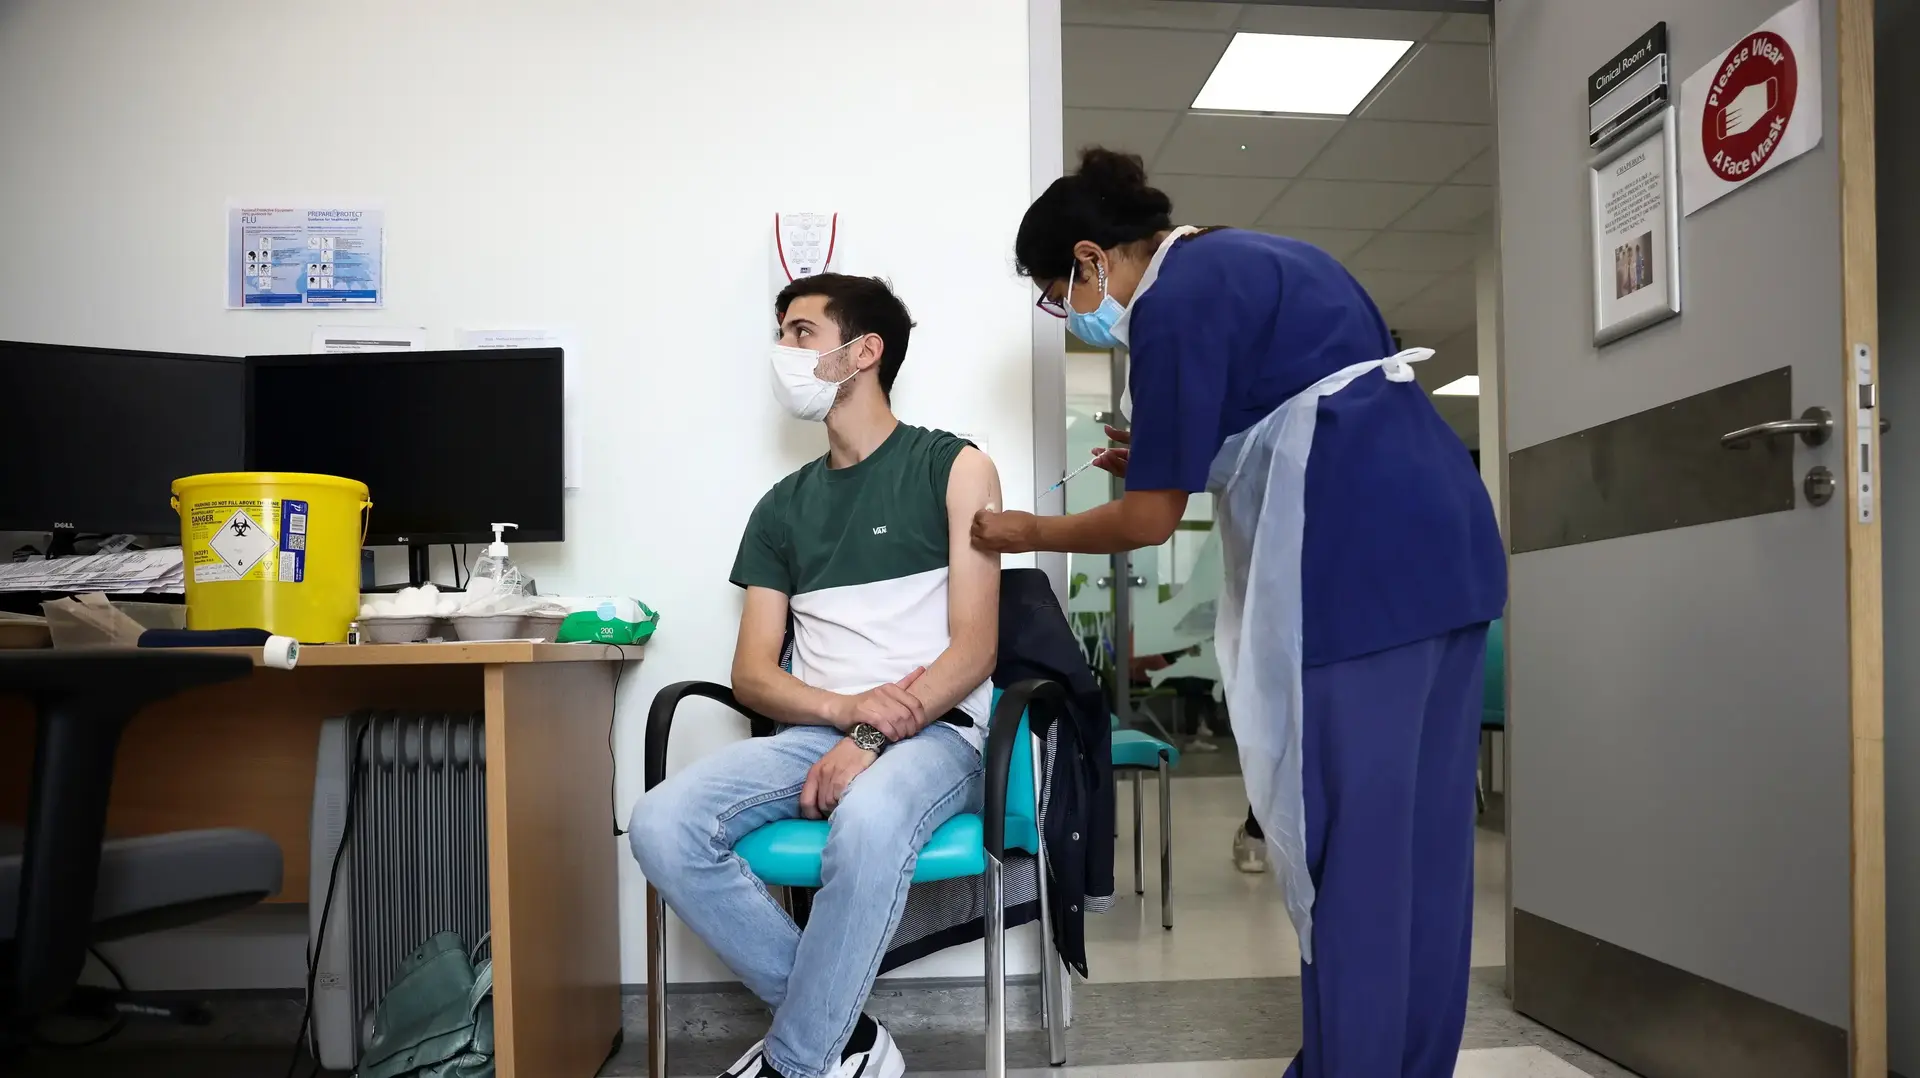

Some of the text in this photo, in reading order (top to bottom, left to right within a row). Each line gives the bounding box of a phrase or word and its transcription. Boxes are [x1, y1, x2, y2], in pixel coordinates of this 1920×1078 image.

[1596, 39, 1652, 90] Clinical Room 4
[1708, 38, 1784, 106] Please Wear
[1616, 153, 1646, 175] CHAPERONE
[1712, 115, 1786, 175] A Face Mask
[192, 515, 213, 523] DANGER
